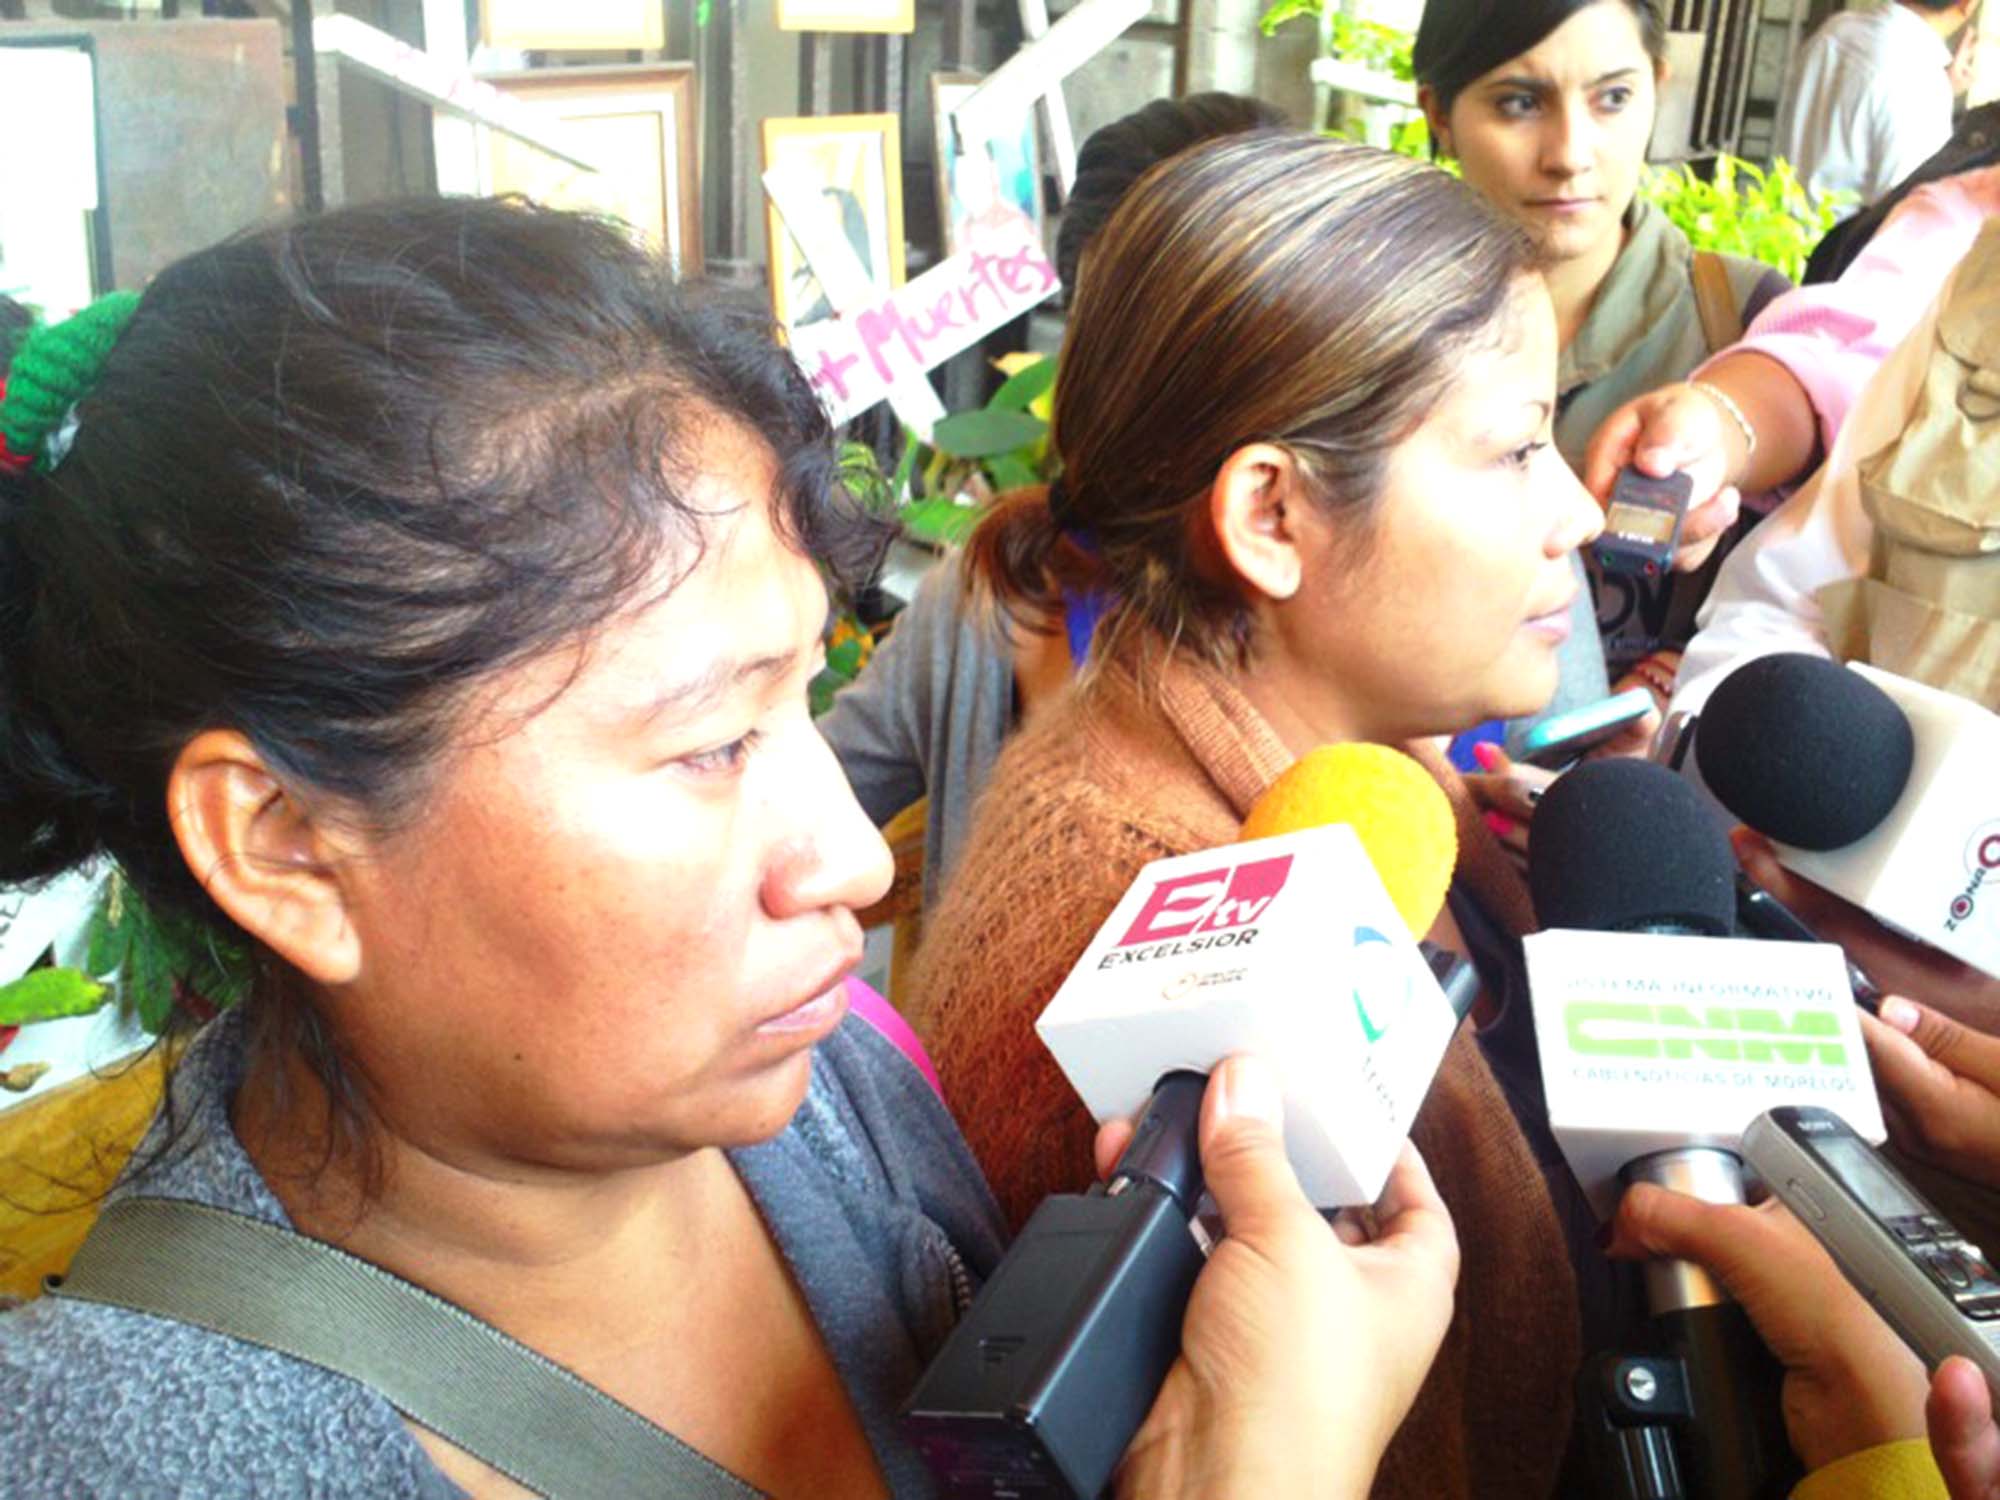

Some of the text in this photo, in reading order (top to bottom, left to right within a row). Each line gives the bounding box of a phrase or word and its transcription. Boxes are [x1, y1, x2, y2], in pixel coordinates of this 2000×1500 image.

[1097, 928, 1259, 970] EXCELSIOR
[1562, 1000, 1849, 1067] CNM
[1732, 1071, 1755, 1089] DE
[1763, 1073, 1857, 1092] MORELOS
